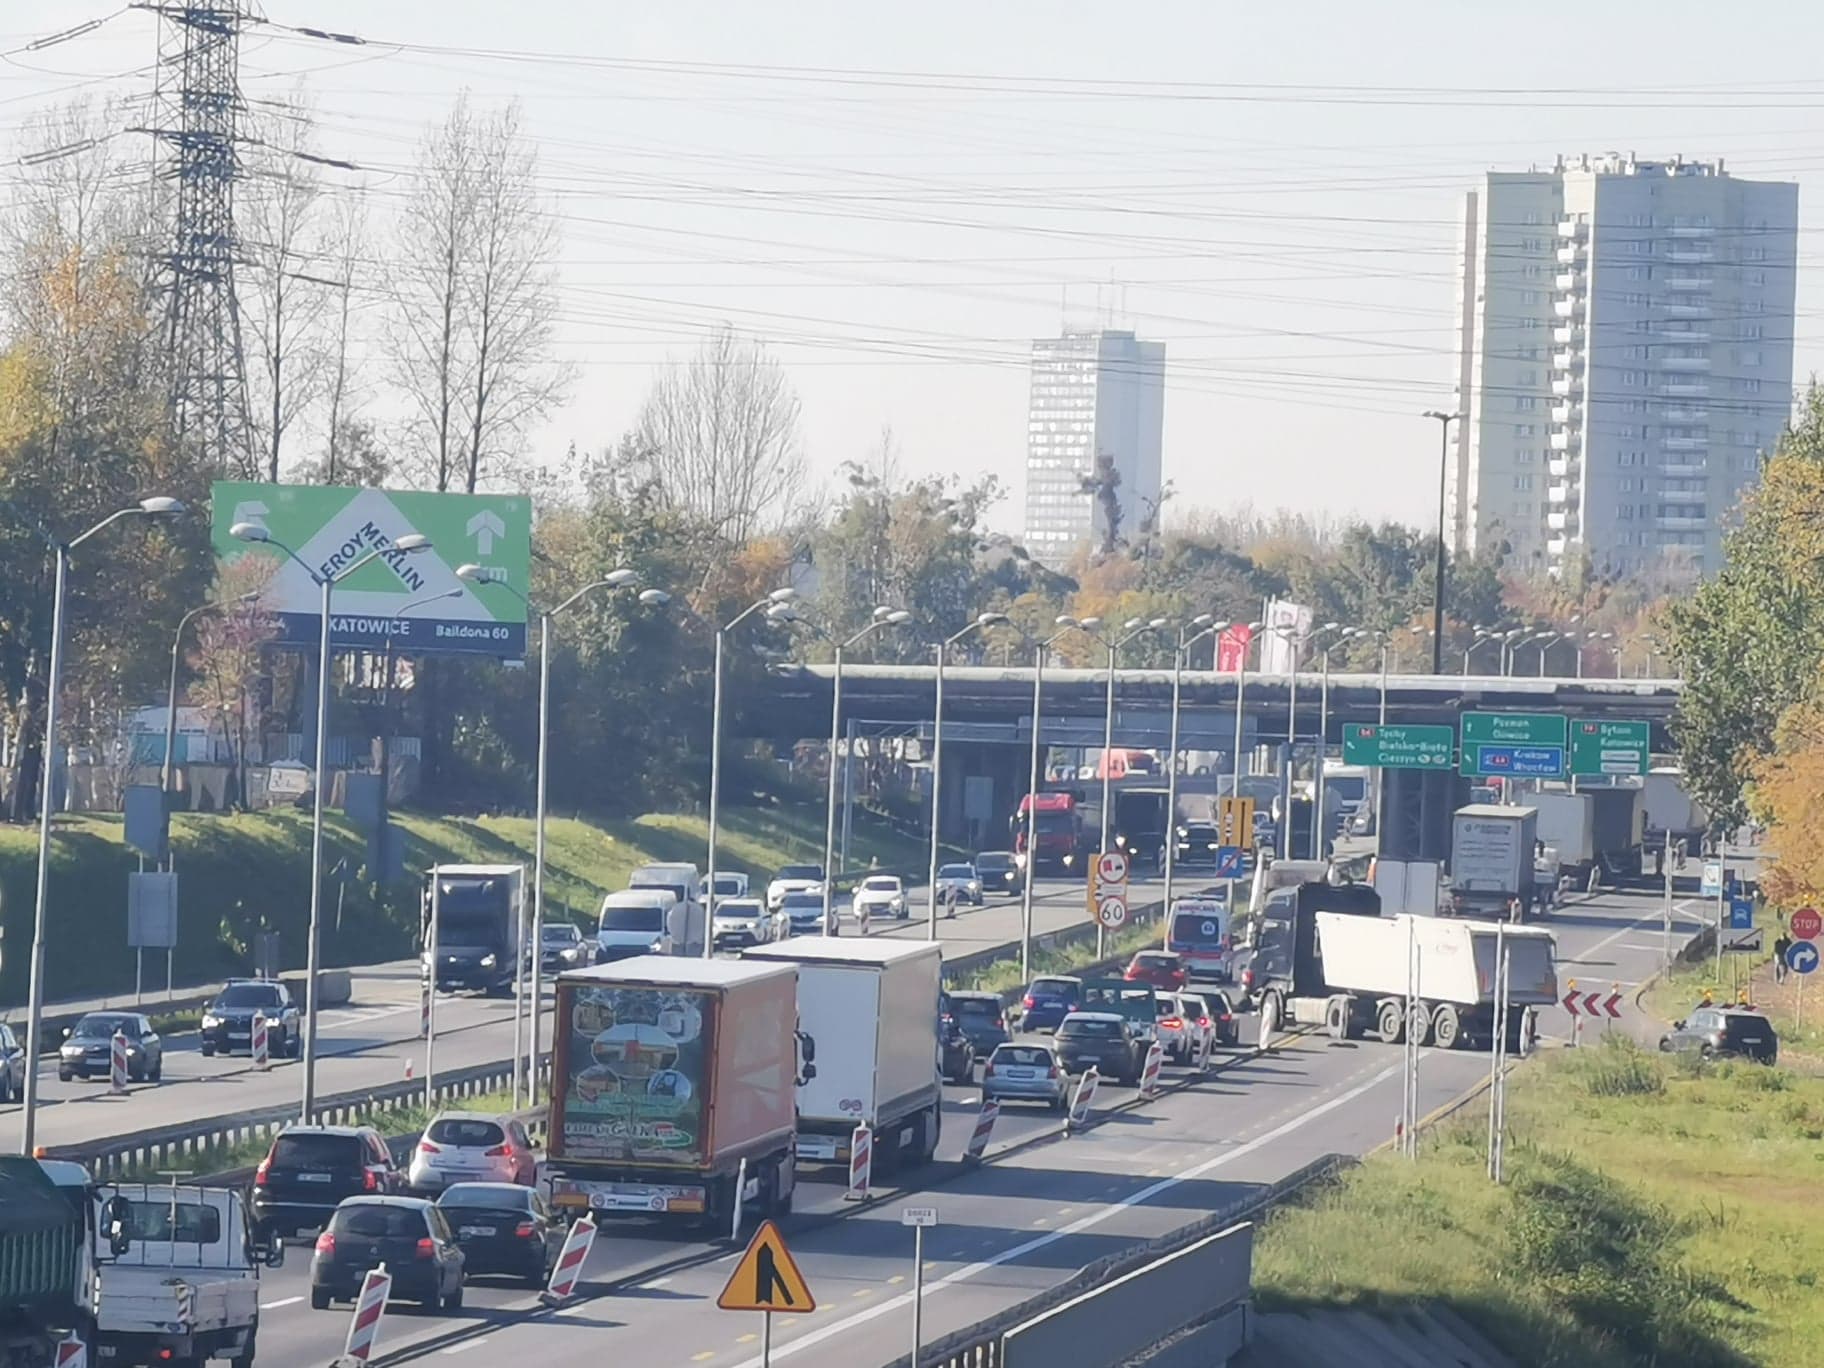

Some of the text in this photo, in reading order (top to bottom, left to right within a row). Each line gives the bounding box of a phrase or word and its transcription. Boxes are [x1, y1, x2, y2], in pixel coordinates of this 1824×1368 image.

[311, 533, 364, 587] LEROY
[360, 521, 424, 592] MERLIN
[328, 618, 410, 635] KATOWICE
[435, 625, 509, 640] Baildona 60
[1101, 904, 1123, 921] 60
[1793, 919, 1818, 929] STOP
